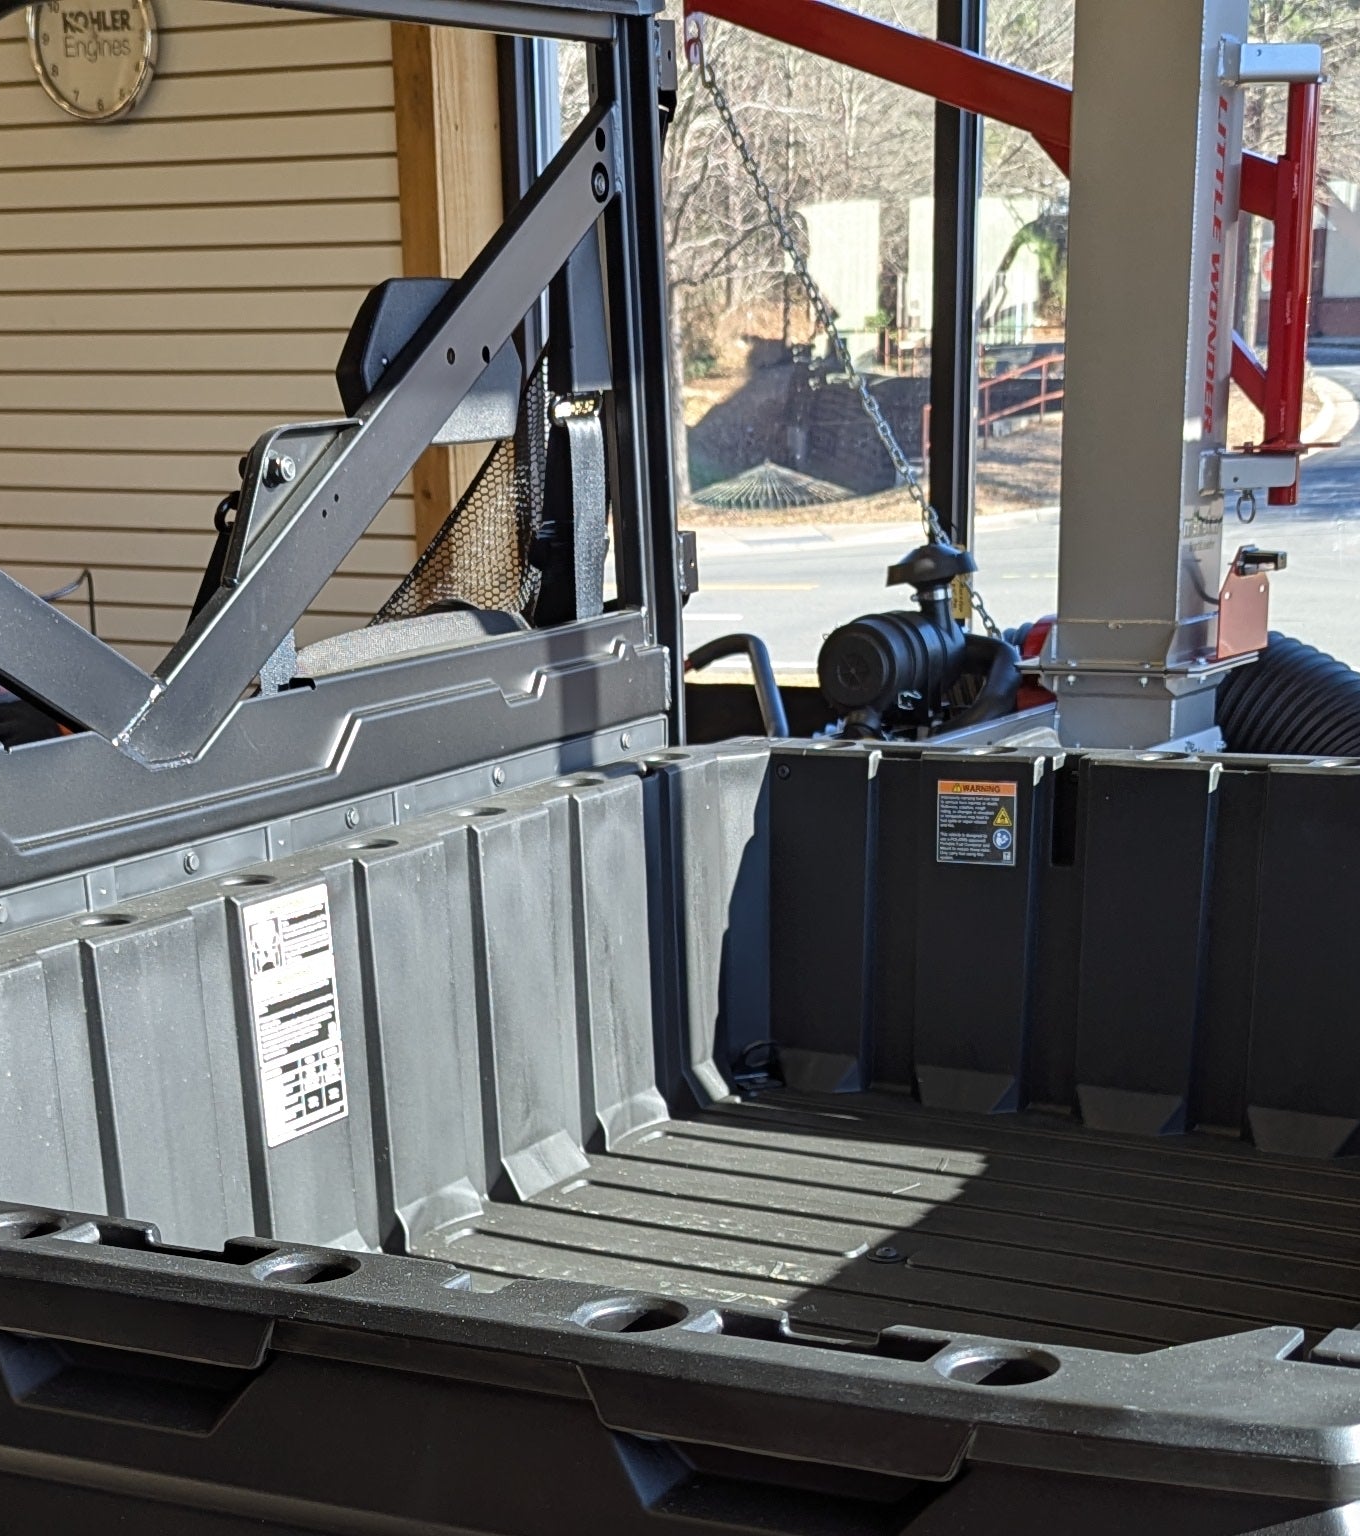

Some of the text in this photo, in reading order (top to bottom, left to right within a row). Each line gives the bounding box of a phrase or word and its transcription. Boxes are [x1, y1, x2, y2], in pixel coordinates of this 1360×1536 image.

[61, 9, 131, 34] KOHLER
[64, 36, 131, 63] Engines
[1203, 95, 1230, 434] LITTLE WONDER
[962, 784, 1001, 793] WARNING
